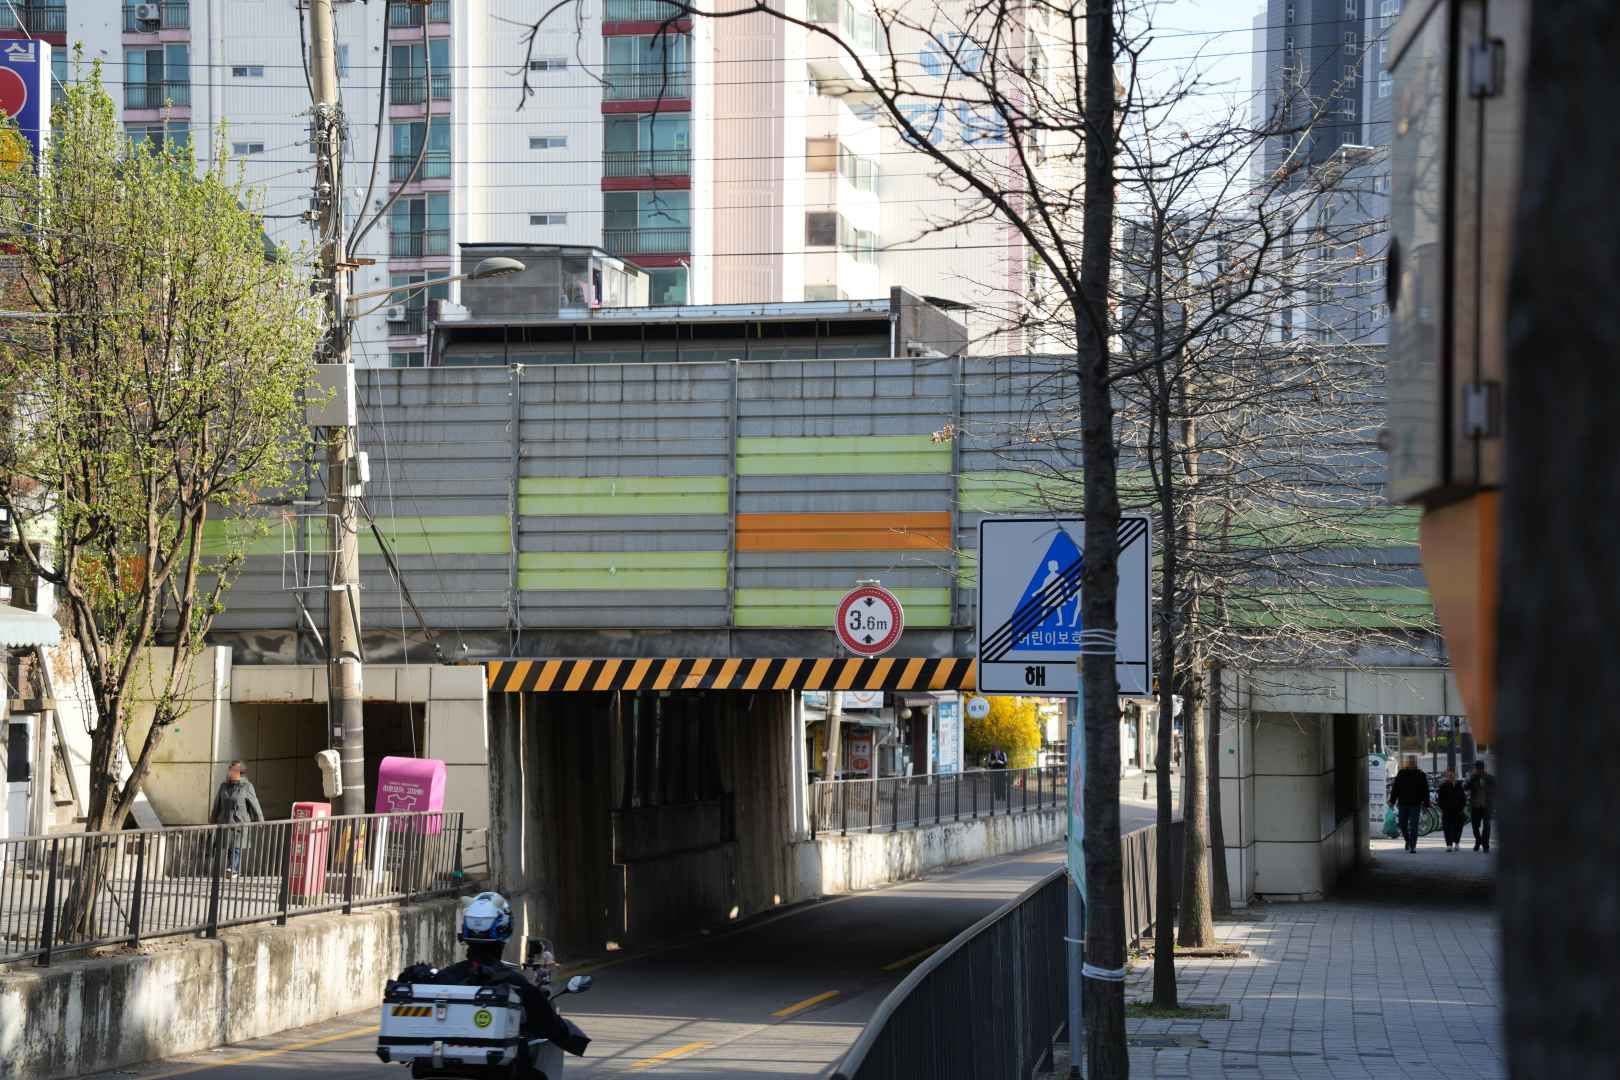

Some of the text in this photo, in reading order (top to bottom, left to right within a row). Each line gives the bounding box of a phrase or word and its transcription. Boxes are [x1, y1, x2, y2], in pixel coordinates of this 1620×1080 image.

[4, 42, 36, 62] 실
[850, 610, 888, 630] 3.6m
[1025, 666, 1046, 686] 해
